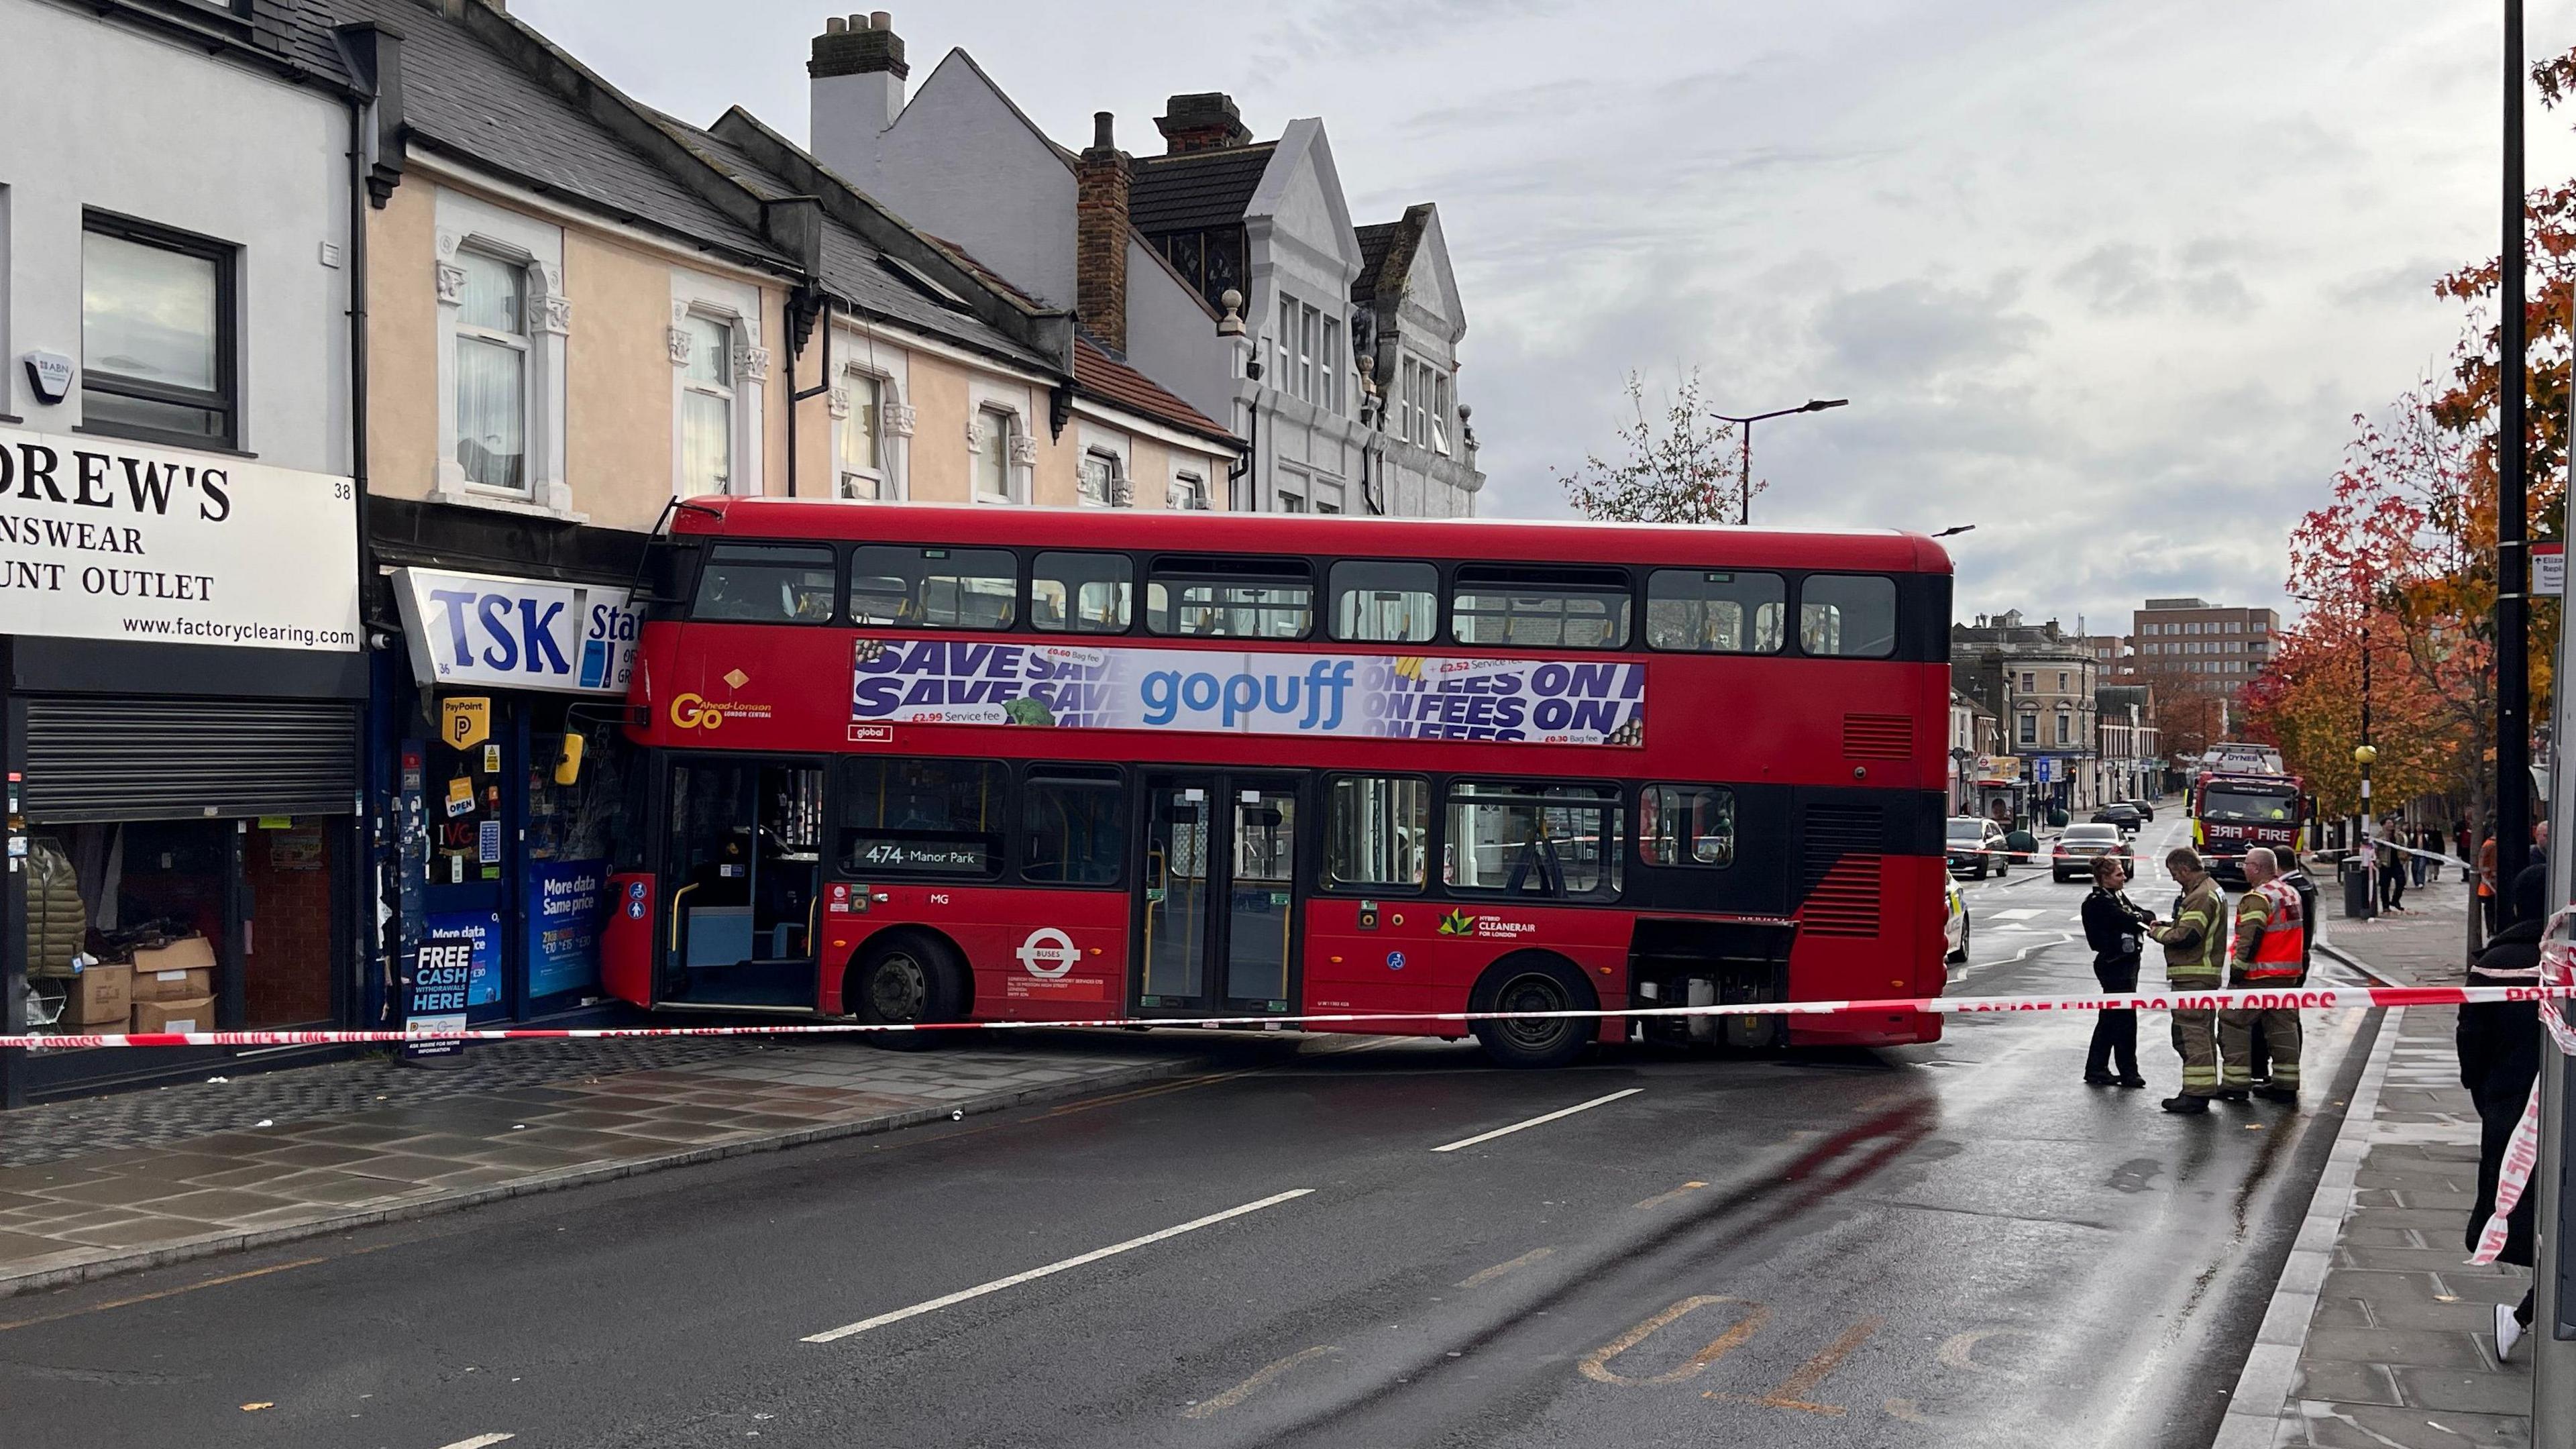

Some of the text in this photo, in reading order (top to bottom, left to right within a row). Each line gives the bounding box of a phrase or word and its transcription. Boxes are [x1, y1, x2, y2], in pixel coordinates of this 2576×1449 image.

[49, 363, 69, 373] ABN
[334, 483, 351, 500] 38
[83, 566, 214, 601] OUTLET
[123, 616, 355, 645] www.factoryclearing.com
[429, 589, 571, 675] TSK
[1072, 650, 1086, 662] Bag
[1087, 653, 1099, 663] fee
[439, 662, 450, 675] 36
[1440, 661, 1470, 673] £2.52
[1531, 663, 1617, 698] ON
[852, 676, 1022, 716] SAVE
[1140, 659, 1354, 730] gopuff
[445, 702, 483, 713] PayPoint
[671, 692, 771, 729] Go Ahead-London
[1362, 692, 1623, 735] ON FEES ON
[912, 713, 943, 722] £2.99
[945, 712, 981, 721] Service
[983, 711, 1000, 721] fee
[856, 727, 884, 738] global
[1570, 735, 1585, 744] Bag
[1585, 735, 1598, 743] fee
[449, 799, 472, 812] OPEN
[2258, 828, 2291, 842] FIRE
[865, 846, 975, 864] 474 Manor Park
[544, 875, 596, 896] More data
[543, 892, 594, 916] Same price
[930, 894, 949, 904] MG
[462, 926, 486, 938] data
[417, 946, 470, 969] FREE
[1036, 950, 1061, 958] BUSES
[417, 968, 468, 985] CASH
[416, 984, 466, 993] WITHDRAWALS
[413, 992, 465, 1011] HERE
